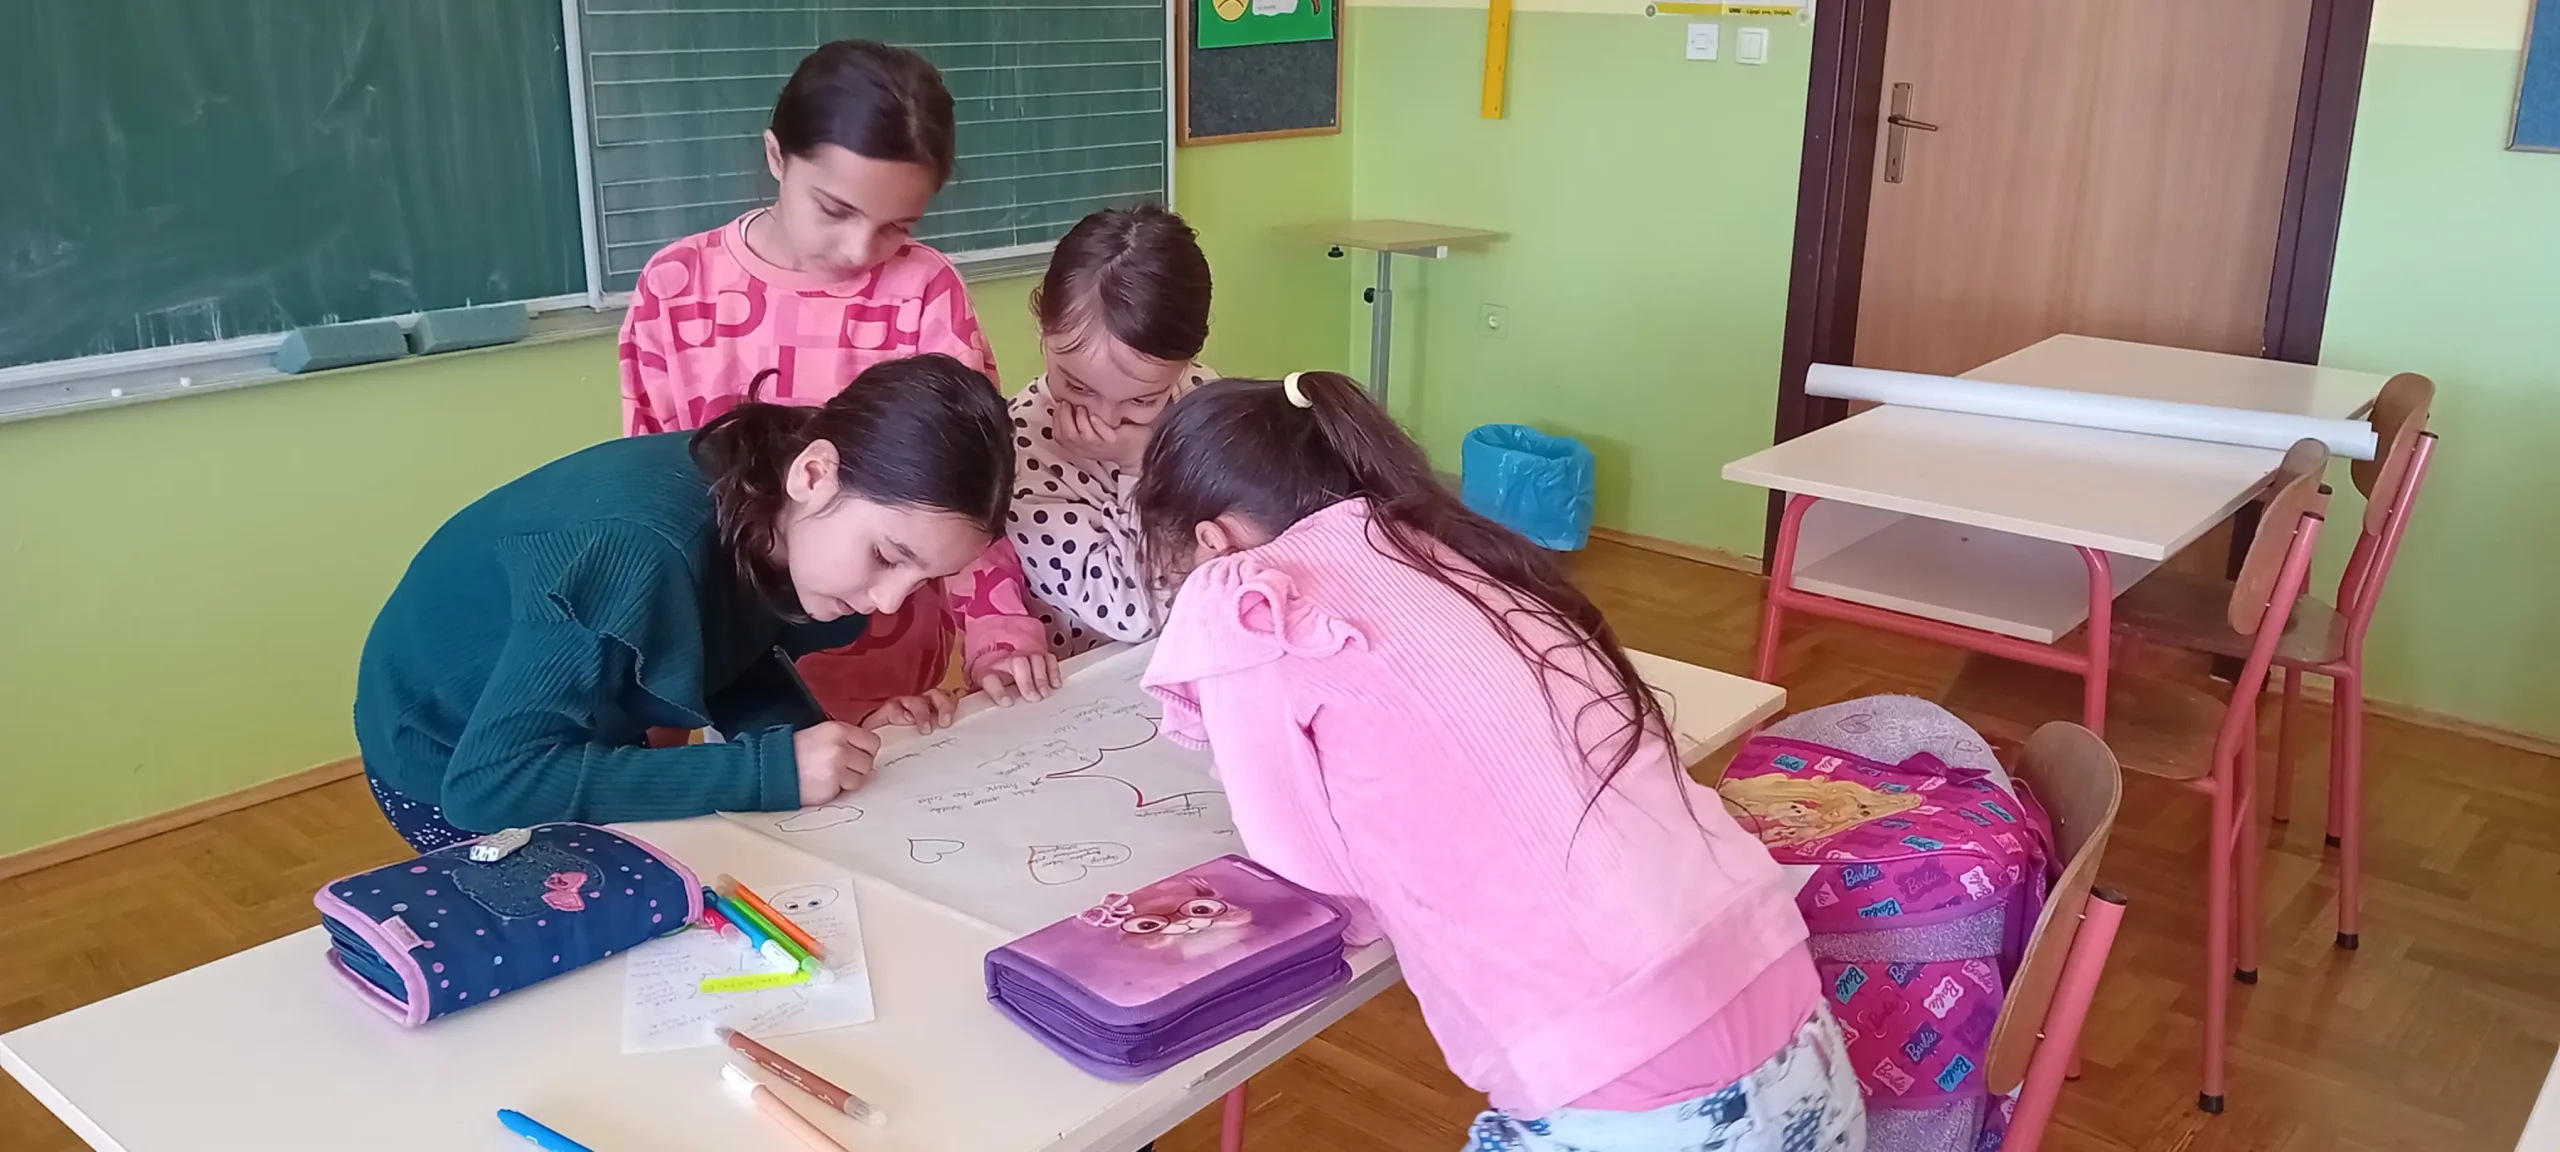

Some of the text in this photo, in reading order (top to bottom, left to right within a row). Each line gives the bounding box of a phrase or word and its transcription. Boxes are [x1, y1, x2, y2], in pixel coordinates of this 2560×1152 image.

[1842, 864, 1880, 887] Barbie
[1905, 870, 1942, 894] Barbie
[1860, 899, 1899, 917] Barbie
[1928, 979, 1960, 1010] Barbie
[1905, 1031, 1938, 1061] Barbie
[1877, 1061, 1907, 1092] Barbie
[1938, 1055, 1970, 1084] Barbie
